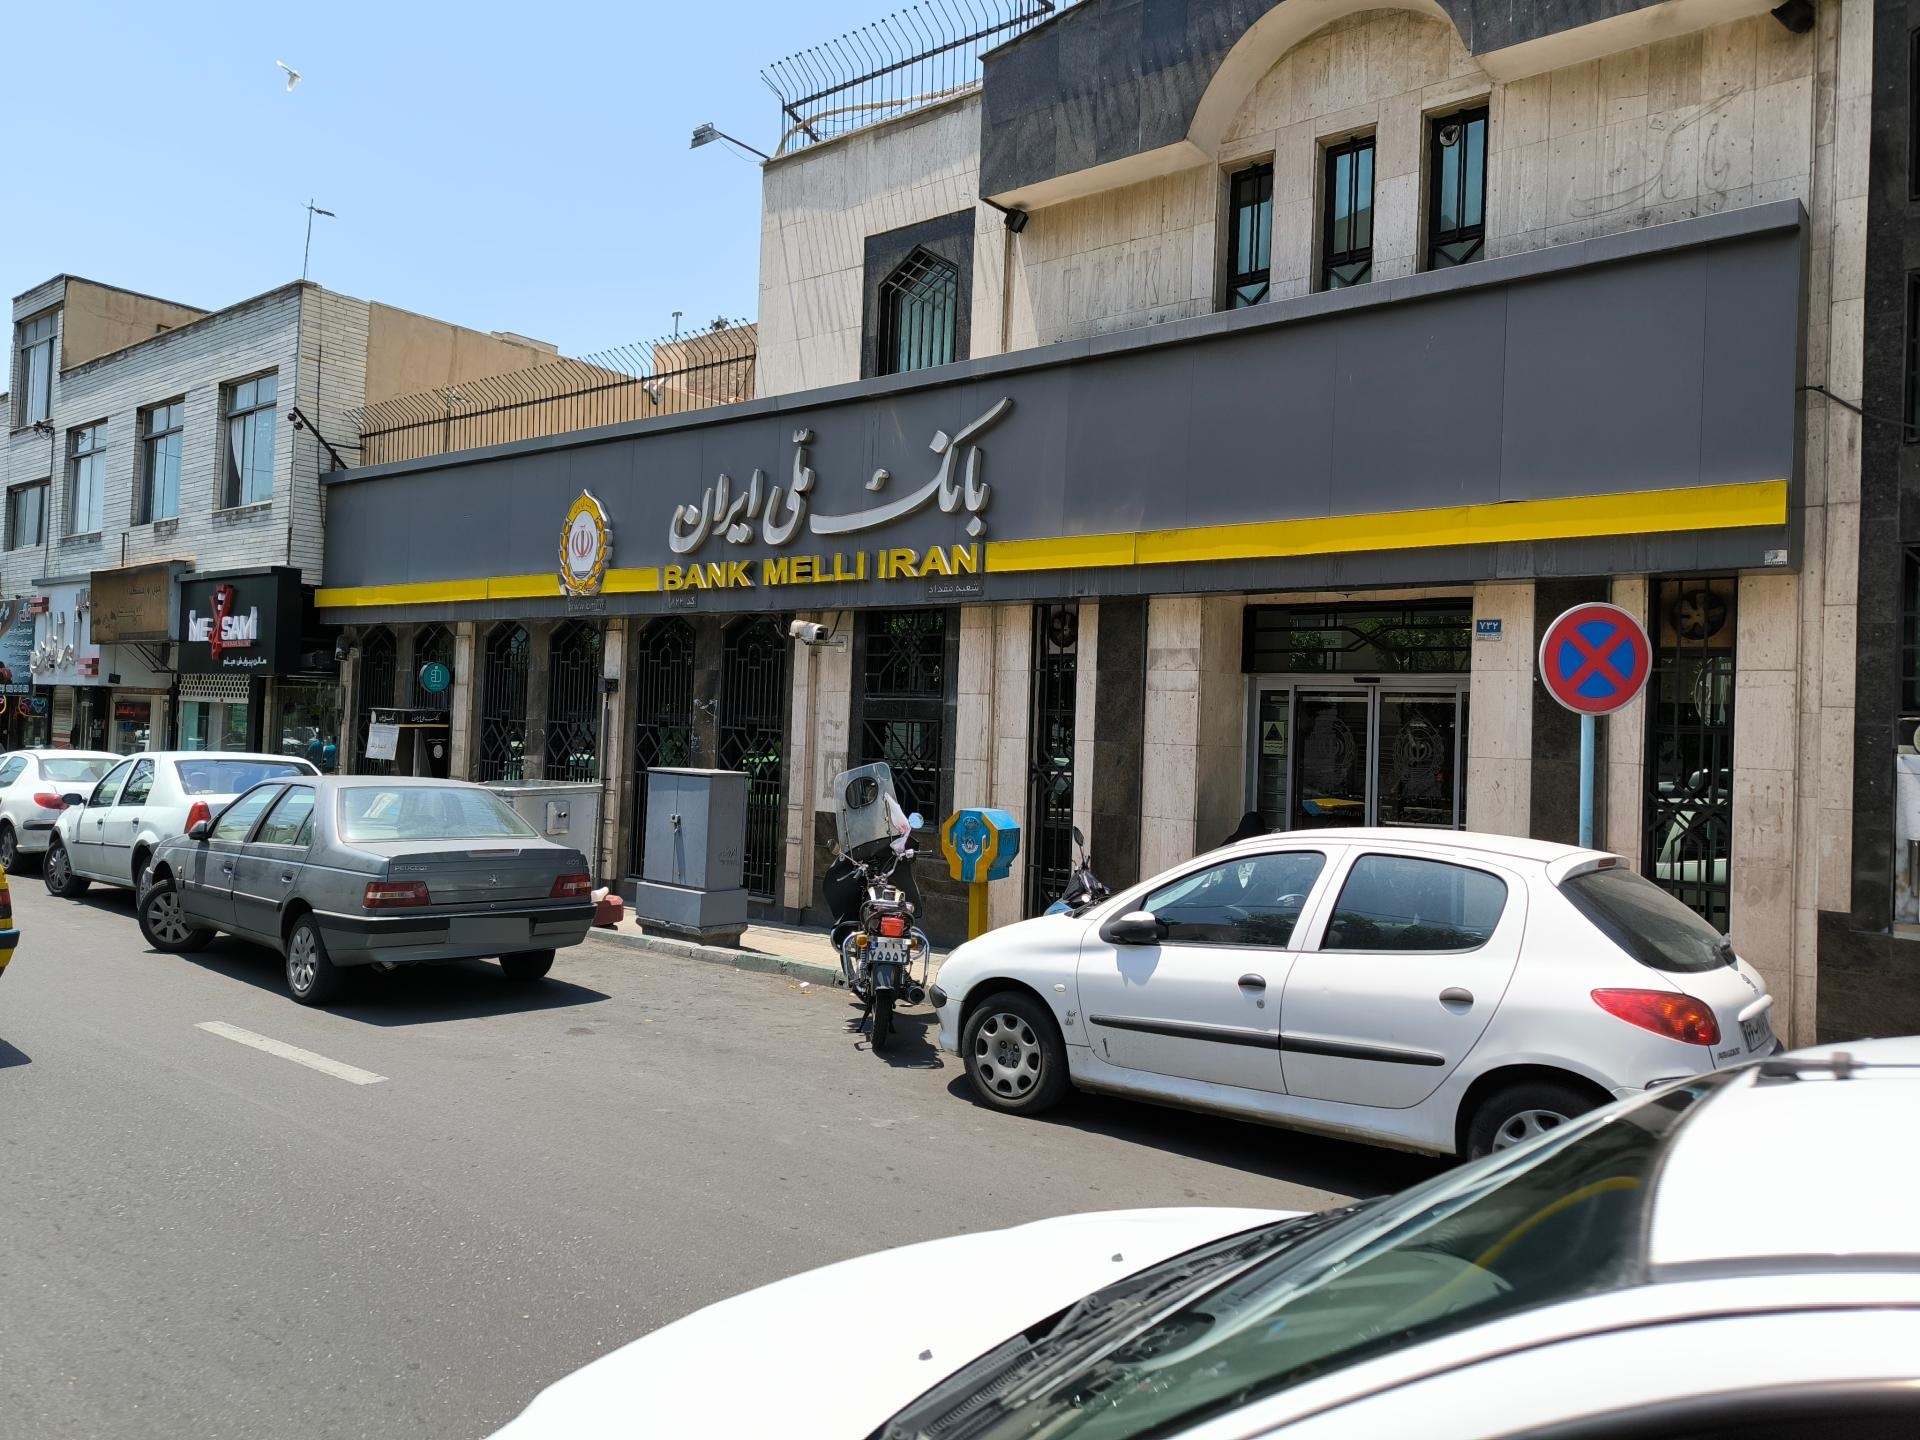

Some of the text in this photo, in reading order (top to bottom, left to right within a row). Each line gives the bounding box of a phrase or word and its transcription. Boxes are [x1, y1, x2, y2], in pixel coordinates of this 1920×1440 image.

[809, 396, 1014, 537] بانک
[668, 467, 765, 554] ایران
[663, 542, 981, 591] BANK MELLI IRAN
[929, 581, 979, 595] شعبه مقداد
[1480, 621, 1499, 630] ۷۳۲
